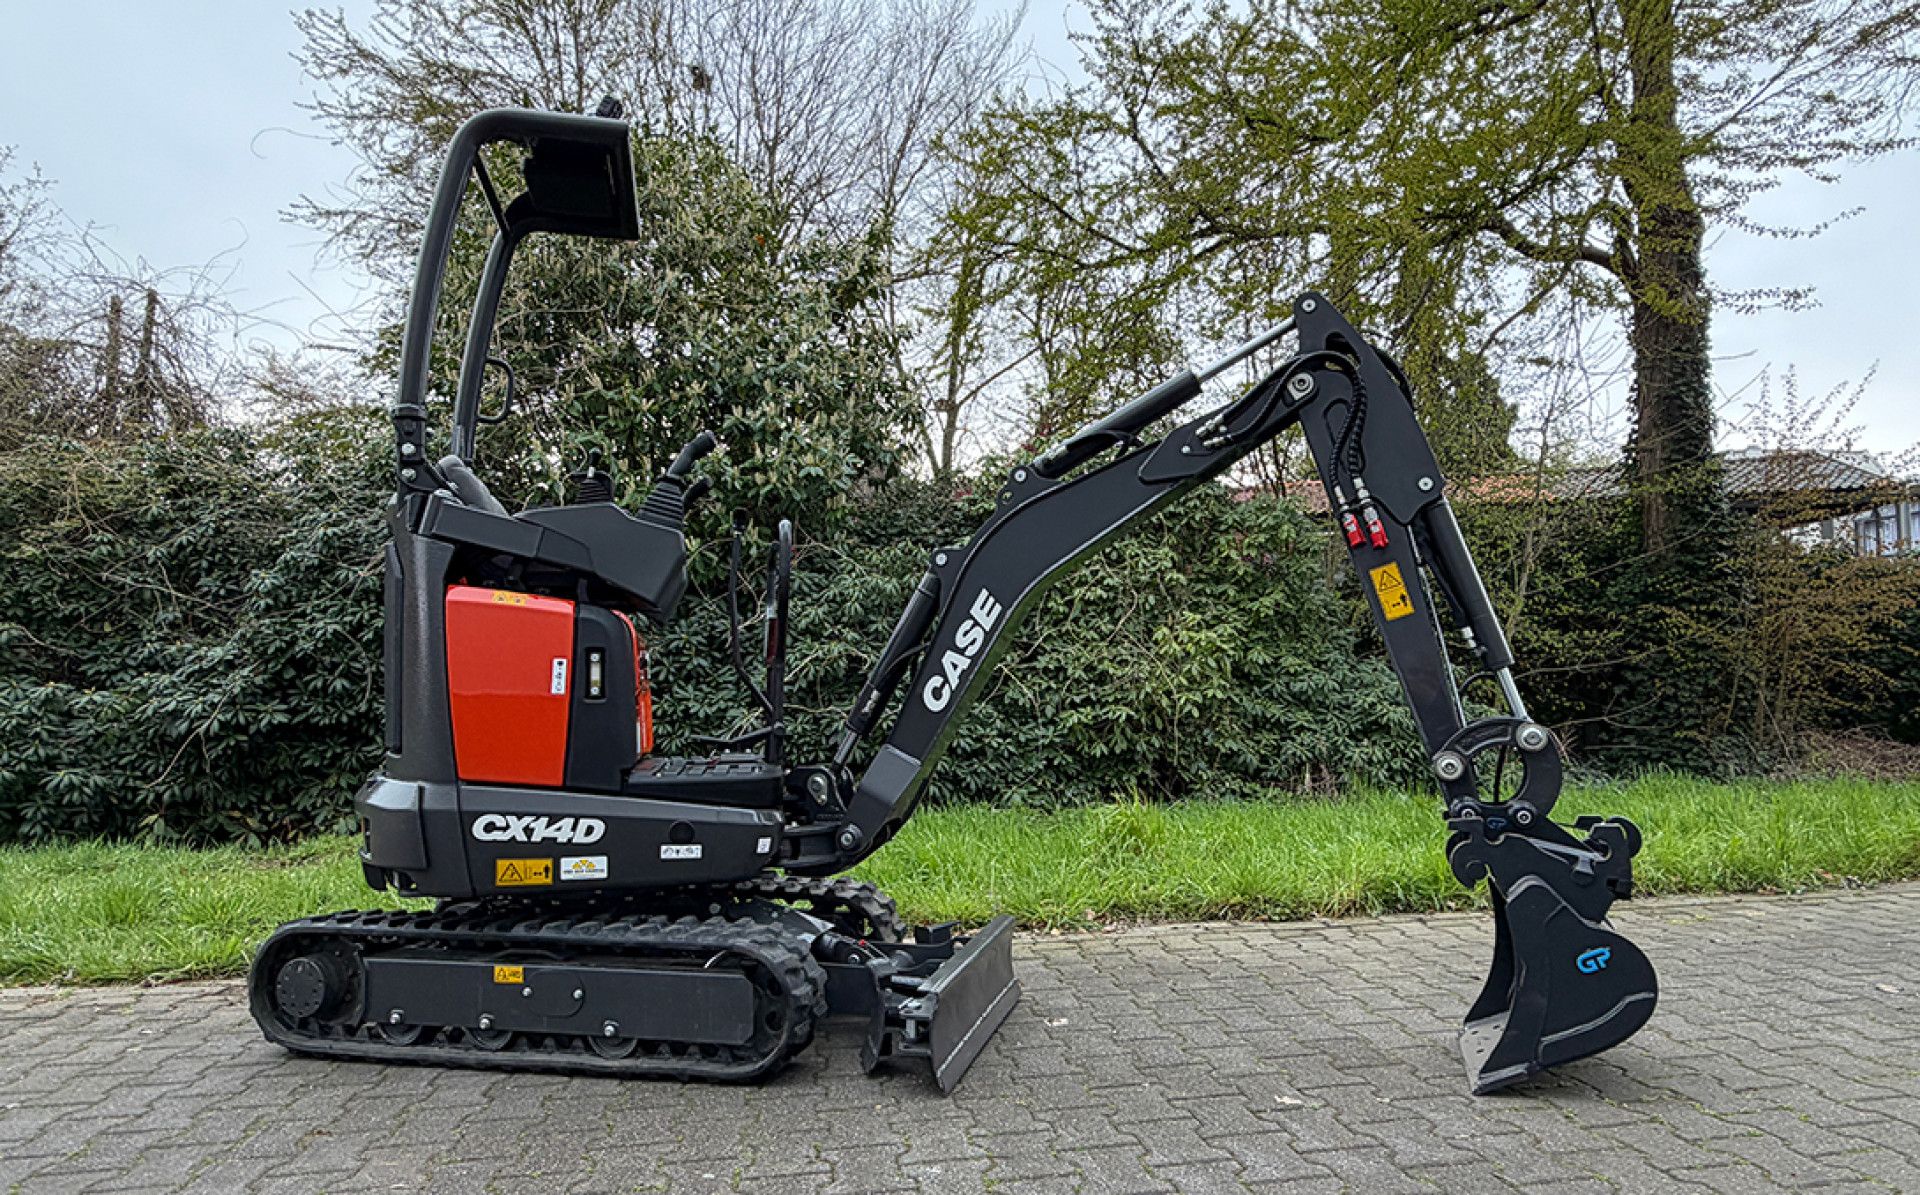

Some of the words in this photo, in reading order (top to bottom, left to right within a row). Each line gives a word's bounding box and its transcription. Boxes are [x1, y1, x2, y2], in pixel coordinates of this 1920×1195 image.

[923, 588, 1002, 712] CASE
[472, 814, 606, 844] CX14D
[1577, 947, 1610, 973] GP
